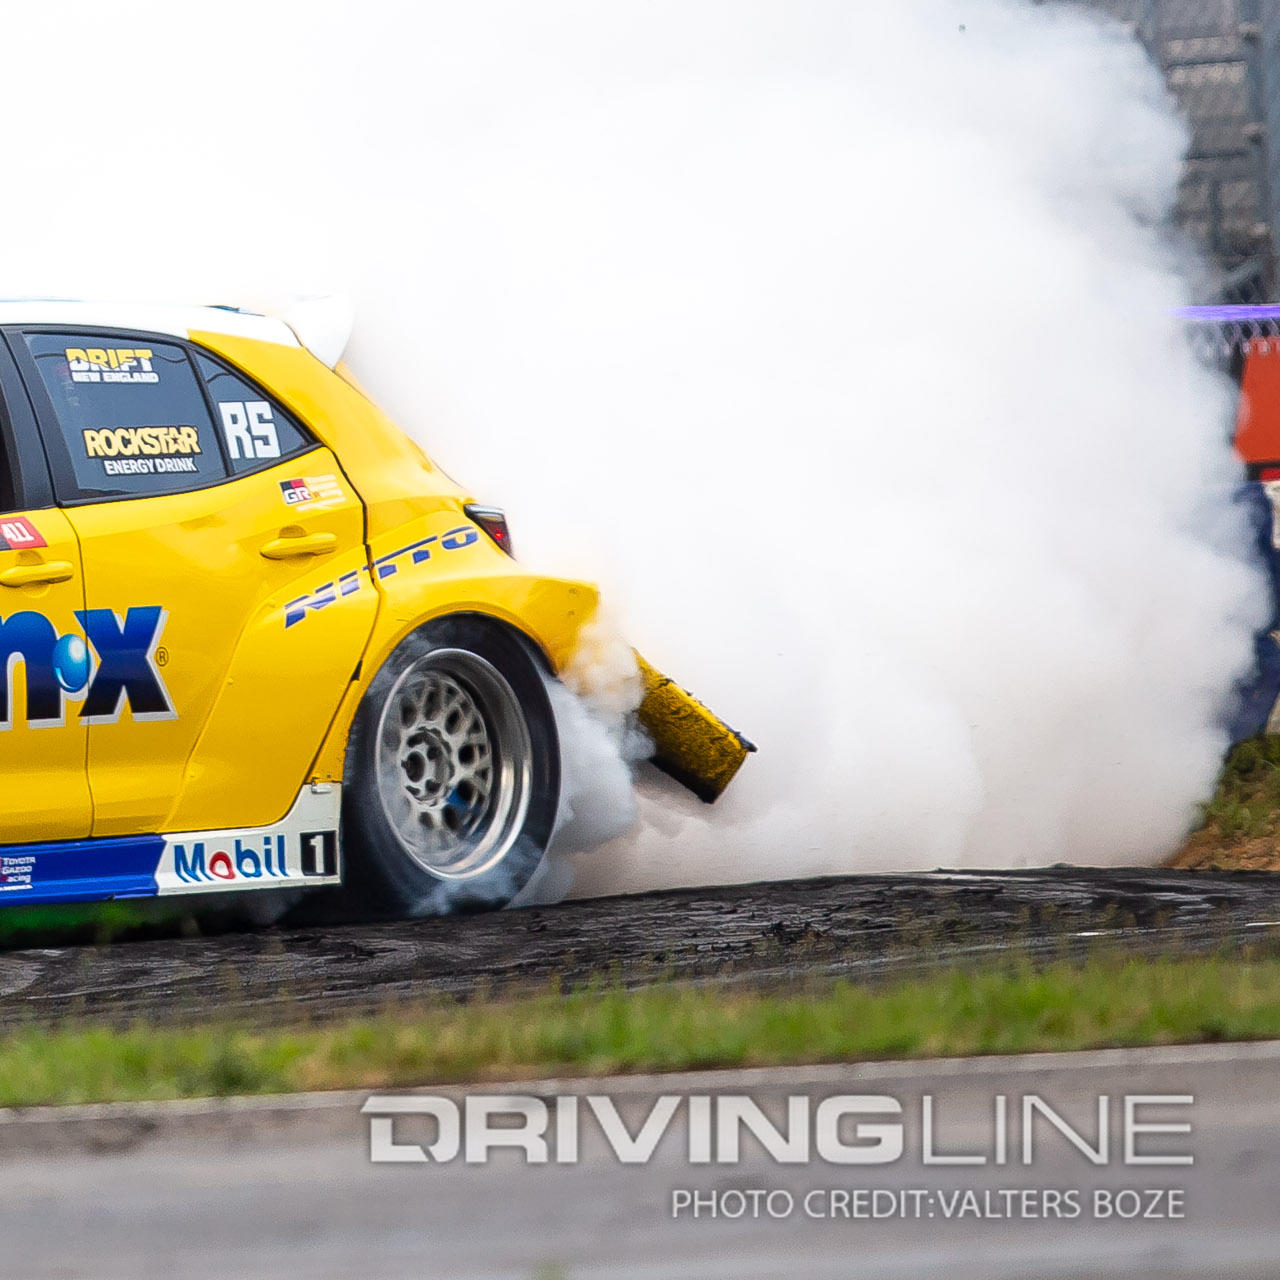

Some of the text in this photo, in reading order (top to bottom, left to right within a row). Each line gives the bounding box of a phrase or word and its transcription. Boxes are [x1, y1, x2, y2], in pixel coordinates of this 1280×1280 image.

[66, 348, 153, 371] DRIFT
[72, 372, 159, 382] NEW ENGLAND
[219, 401, 281, 459] RS
[83, 426, 201, 457] ROCKSTAR
[104, 458, 197, 475] ENERGY DRINK
[283, 486, 311, 504] GR
[1, 522, 34, 543] 411
[284, 526, 478, 629] NITTO
[3, 856, 35, 865] TOYOTA
[174, 835, 289, 883] Mobil
[1, 866, 32, 874] GAZOO
